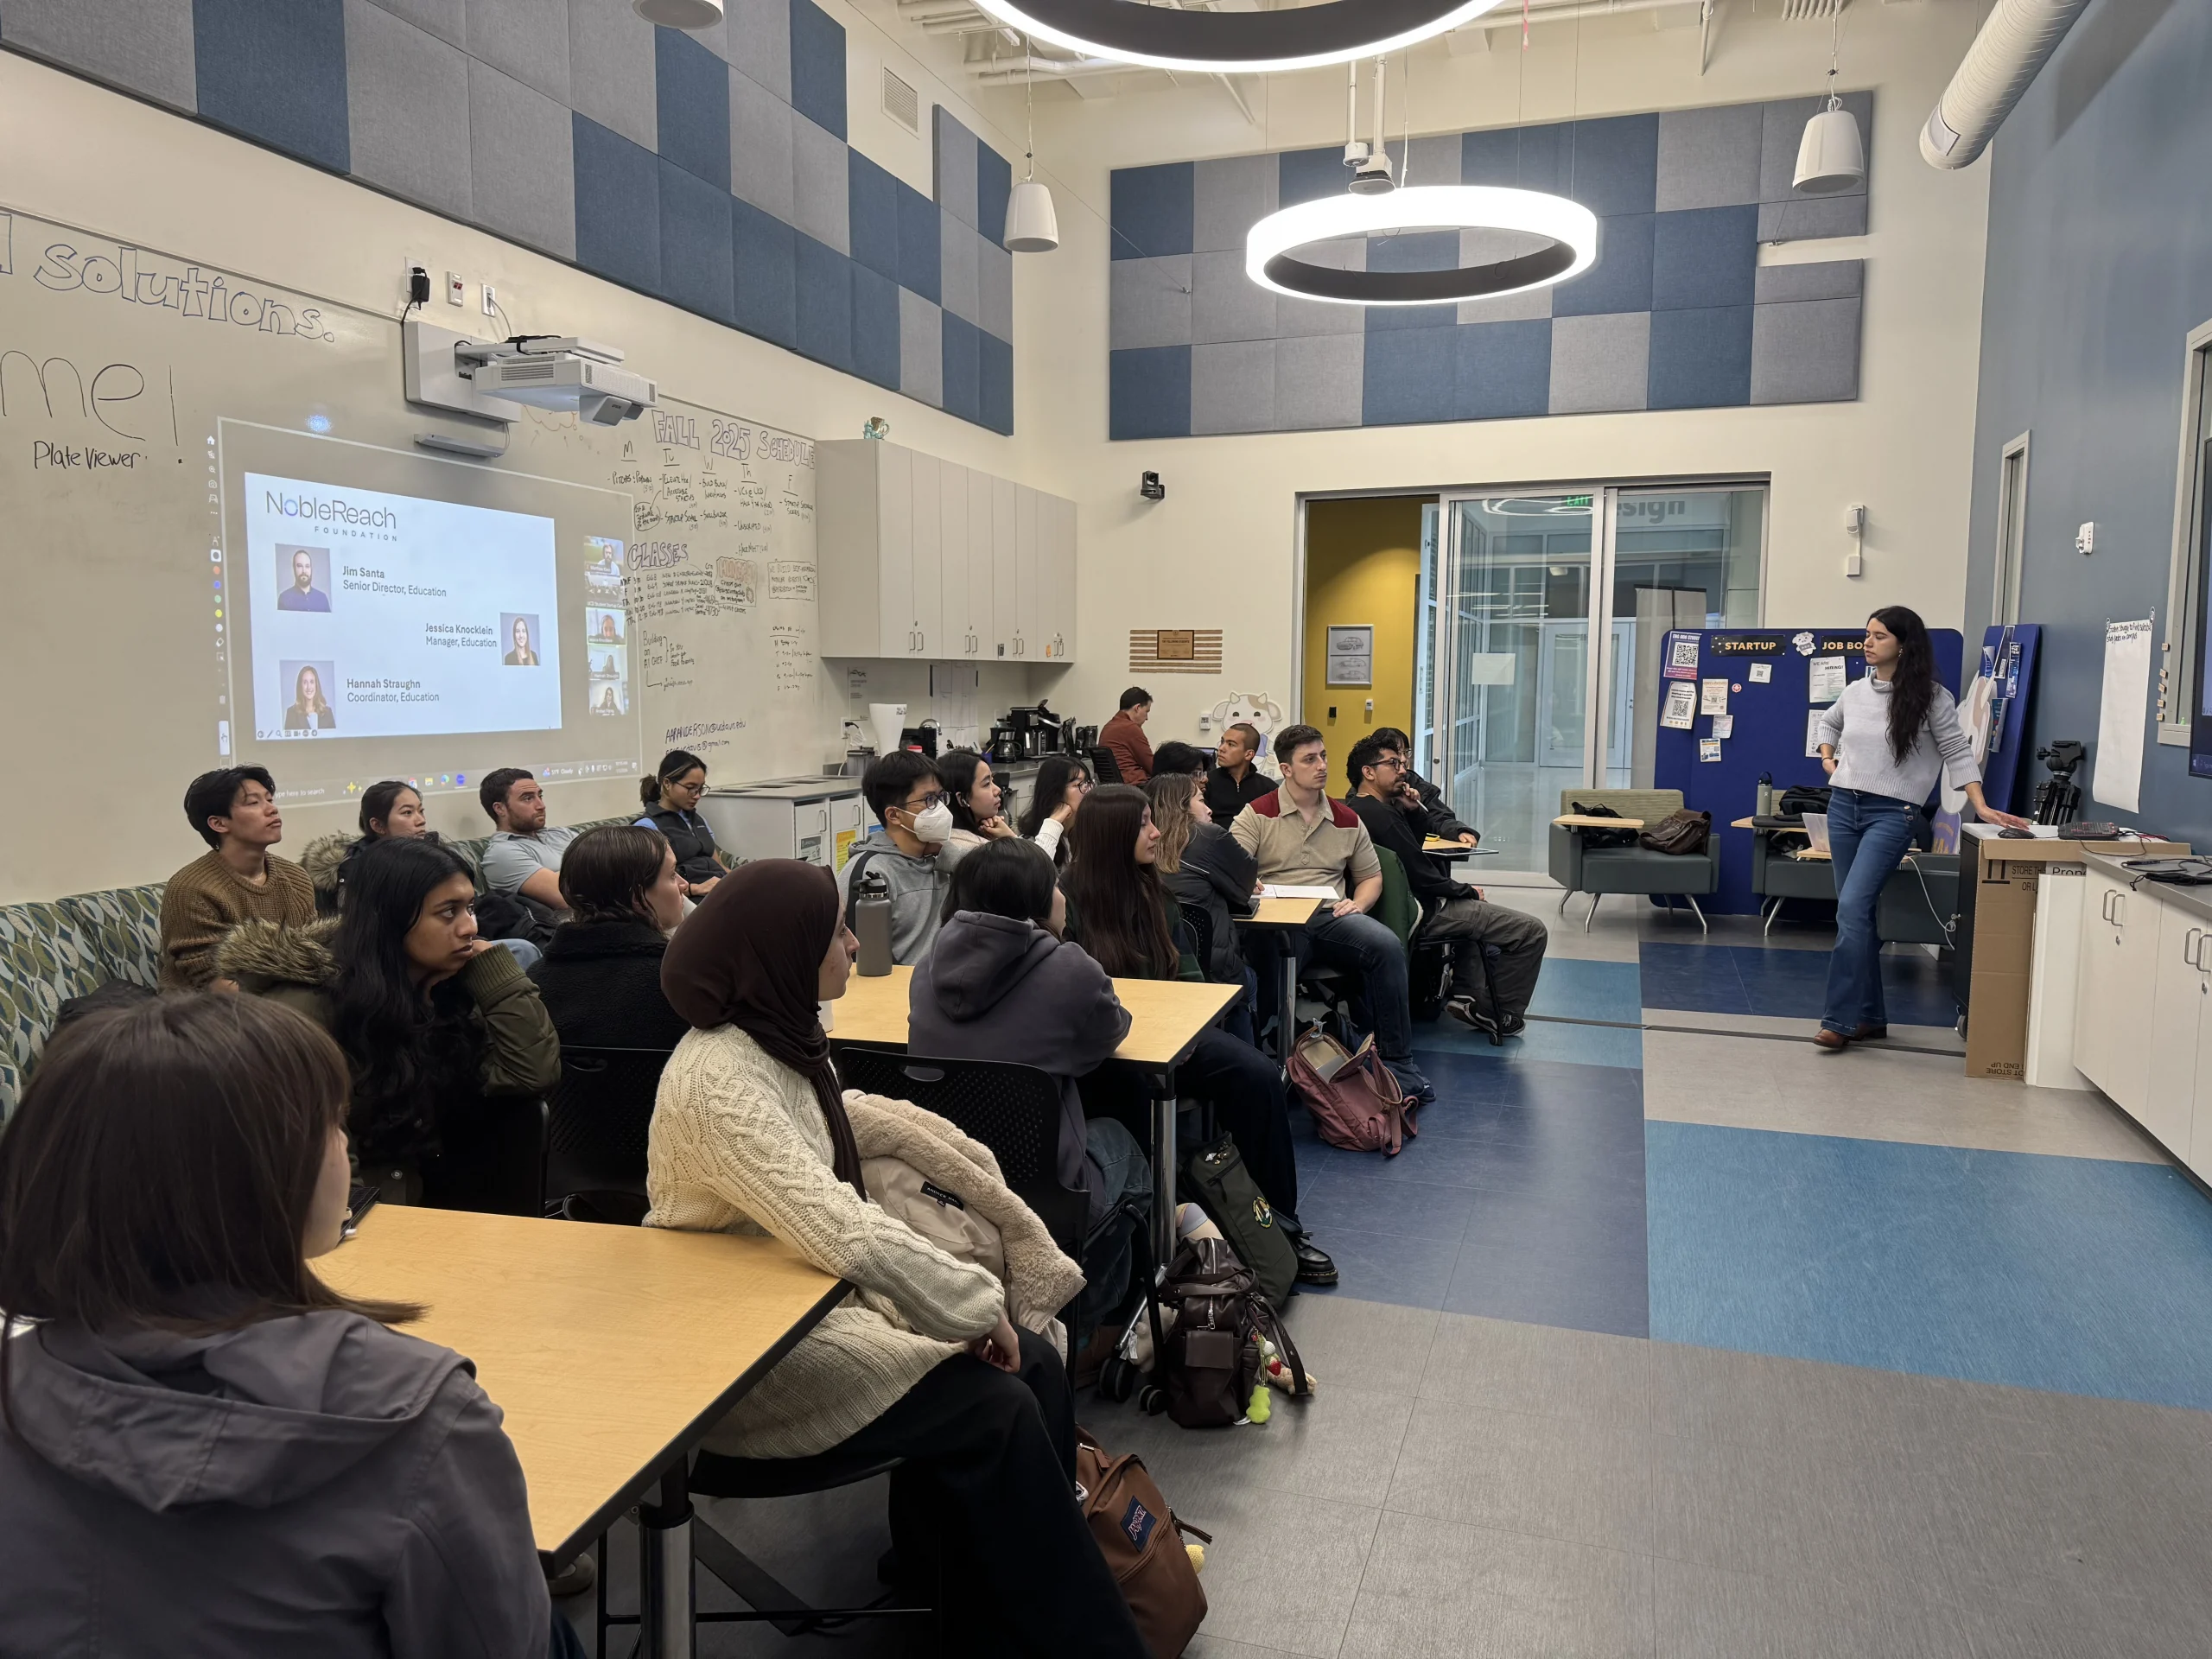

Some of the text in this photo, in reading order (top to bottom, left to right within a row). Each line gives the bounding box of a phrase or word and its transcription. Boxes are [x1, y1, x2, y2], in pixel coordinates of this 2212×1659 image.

[652, 410, 815, 469] FALL 2025 SCHEDULE
[623, 440, 633, 458] M
[703, 455, 713, 471] W
[741, 463, 751, 479] Th
[788, 474, 793, 490] F
[266, 491, 397, 529] NobleReach
[314, 526, 398, 542] FOUNDATION
[627, 542, 689, 571] CLASSES
[343, 566, 385, 579] Jim Santa
[343, 580, 447, 598] Senior Director, Education
[425, 623, 493, 636] Jessica Knocklein
[426, 636, 498, 649] Manager, Education
[1725, 641, 1865, 651] STARTUP JOB BO
[346, 678, 421, 690] Hannah Straughn
[346, 692, 440, 703] Coordinator, Education
[307, 787, 325, 796] search
[2012, 865, 2033, 875] STORE
[2022, 881, 2032, 891] OR
[1986, 1067, 2012, 1076] STORE
